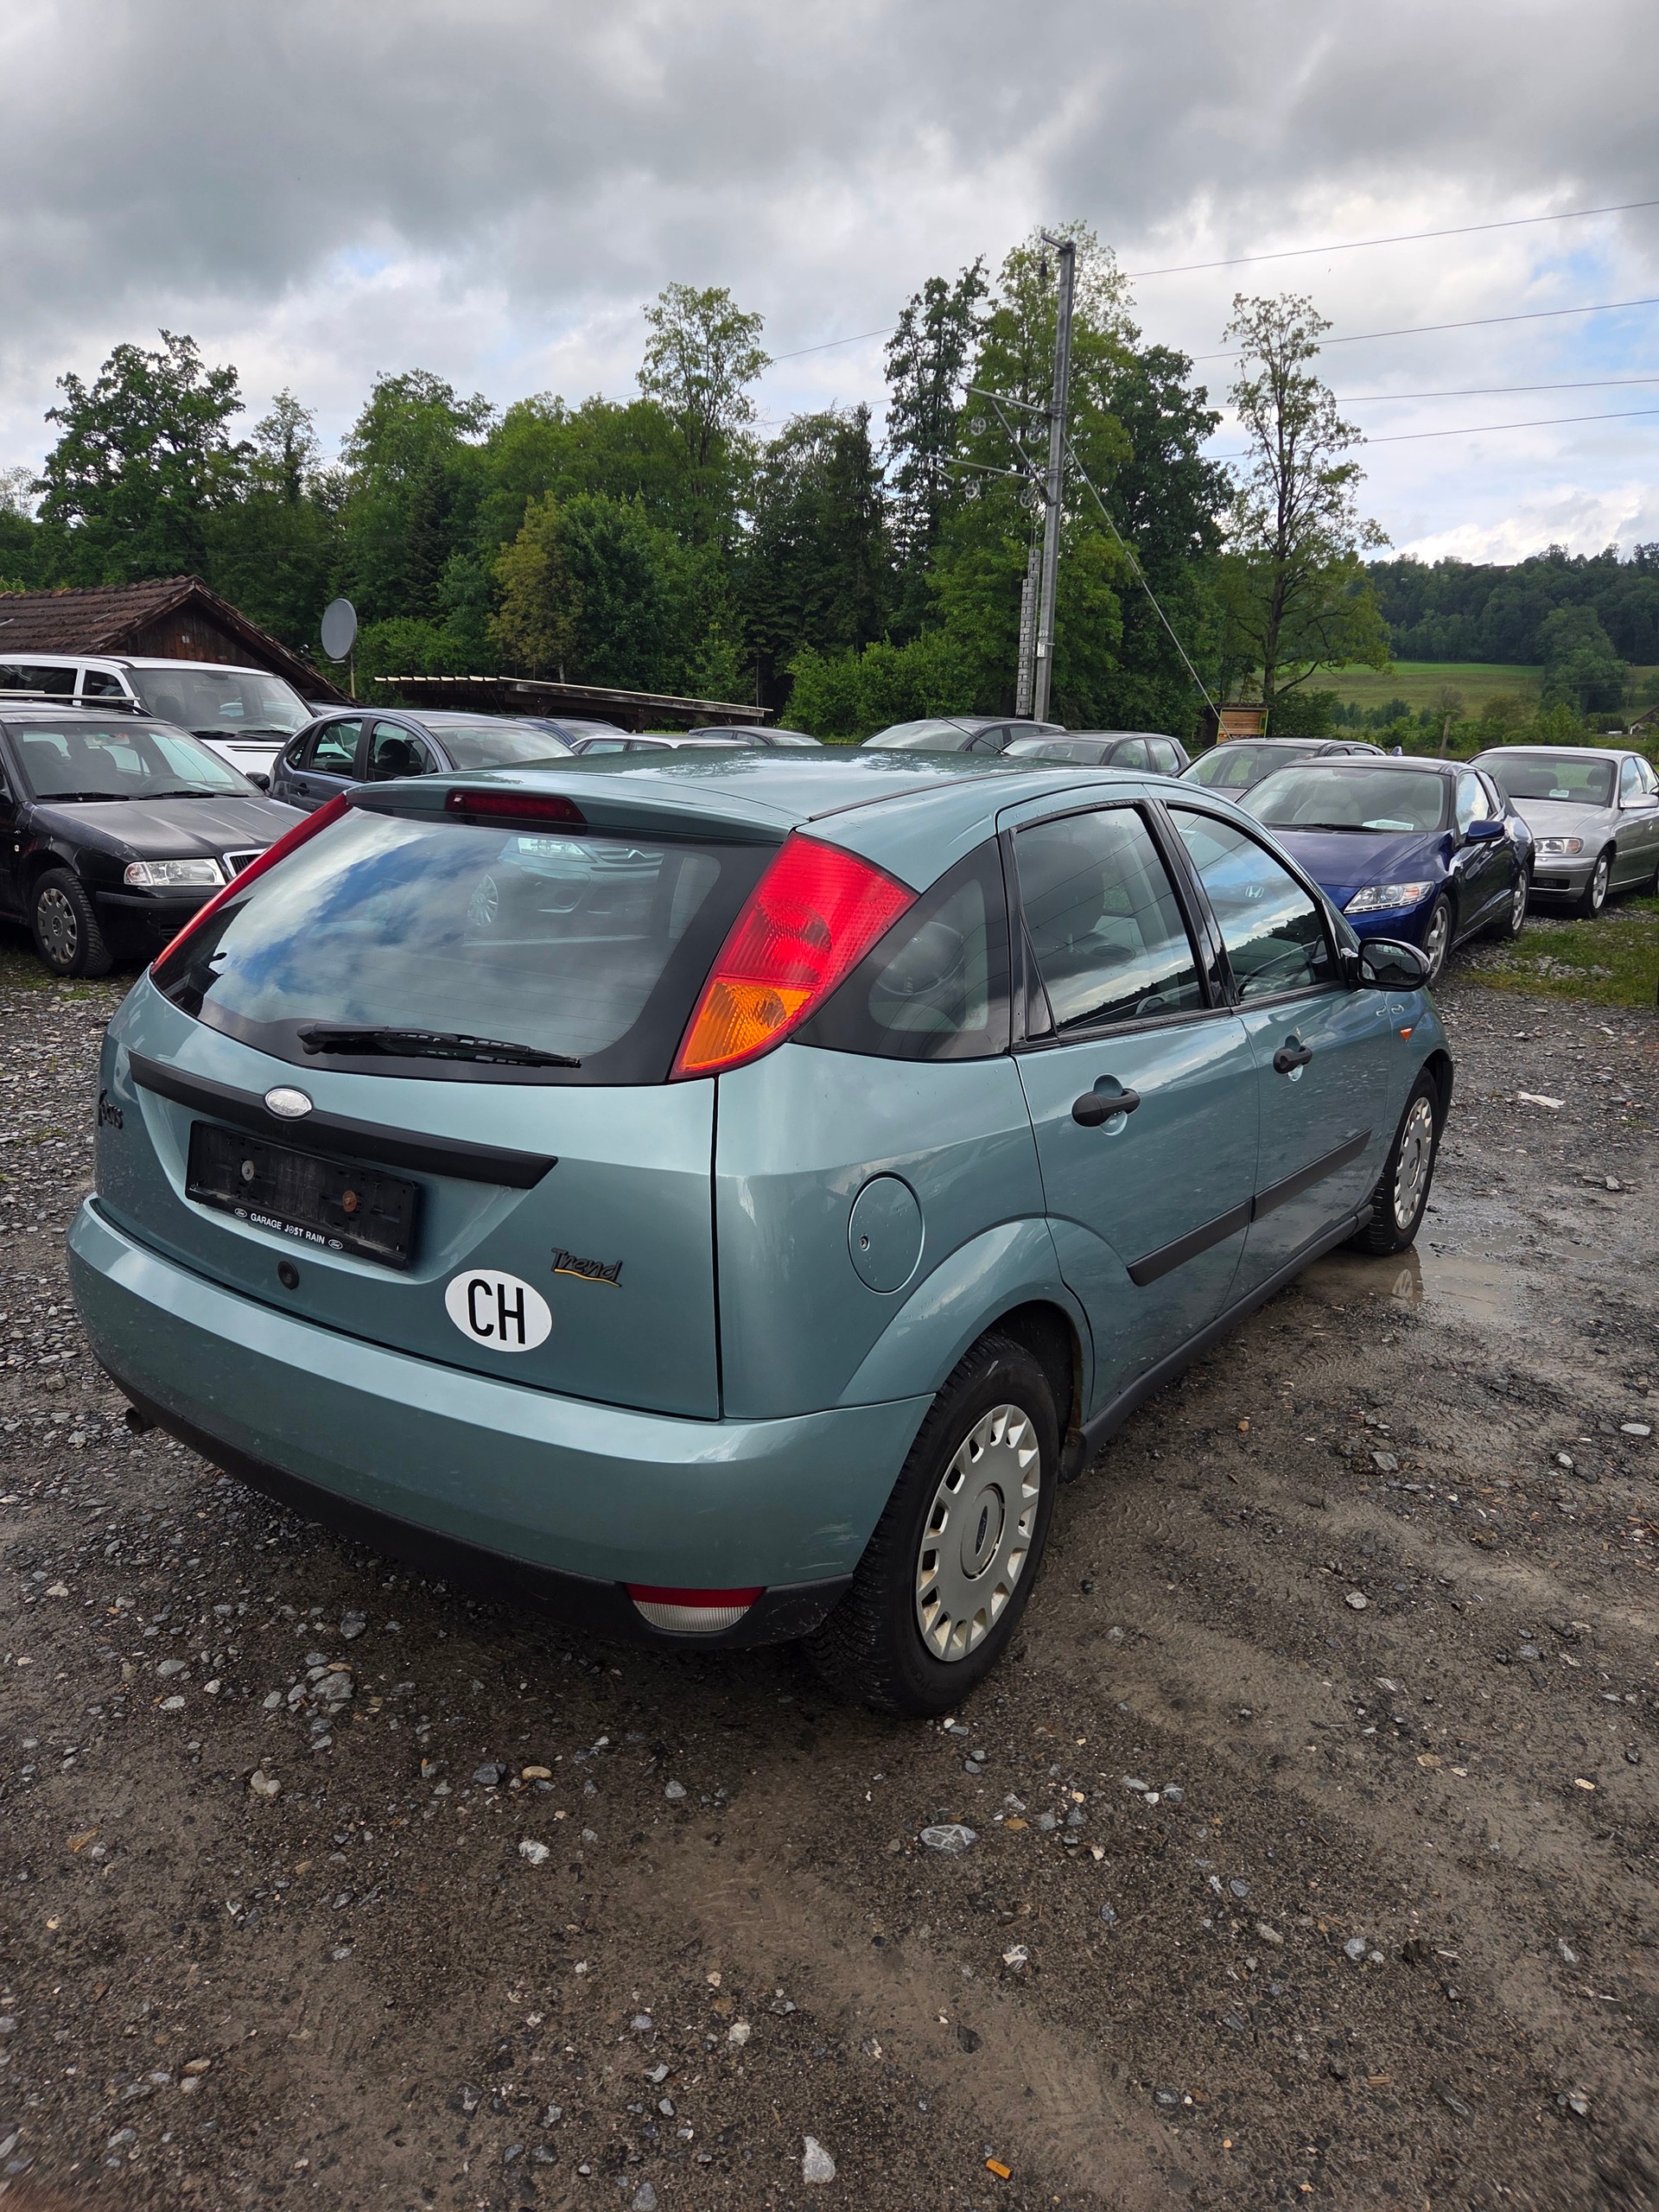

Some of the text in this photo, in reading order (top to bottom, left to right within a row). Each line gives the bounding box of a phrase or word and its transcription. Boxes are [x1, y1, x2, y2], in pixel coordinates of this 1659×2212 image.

[251, 1212, 325, 1244] GARAGE JOST RAIN
[550, 1247, 623, 1284] Trend
[467, 1278, 525, 1344] CH
